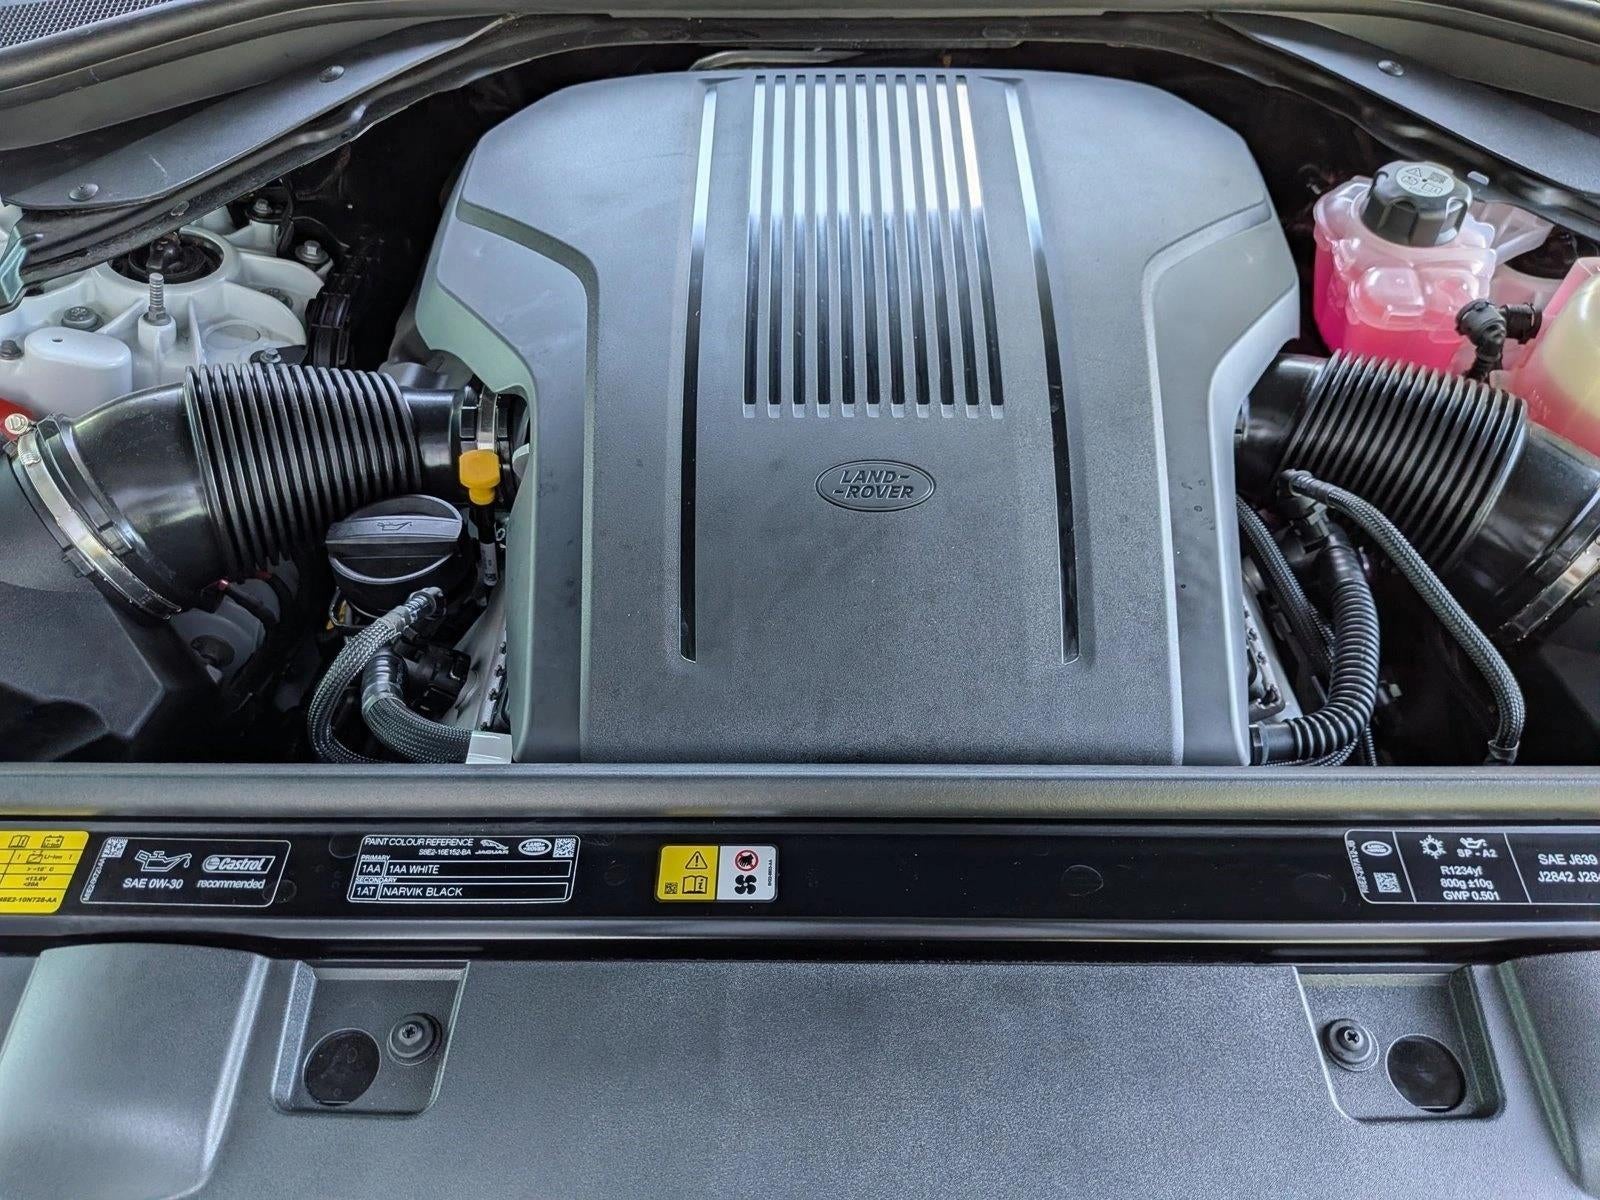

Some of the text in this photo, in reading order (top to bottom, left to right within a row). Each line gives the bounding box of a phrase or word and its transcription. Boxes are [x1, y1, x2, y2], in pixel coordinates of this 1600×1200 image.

[364, 837, 474, 847] PAINT COLOUR REFERENCE
[1457, 848, 1473, 858] SP
[1482, 848, 1499, 858] A2
[219, 857, 266, 871] Castrol
[1537, 853, 1598, 866] SAE J639
[362, 864, 381, 873] 1AA
[389, 864, 440, 874] 1AA WHITE
[1537, 870, 1576, 883] J2842
[122, 877, 184, 889] SAE 0W-30
[196, 879, 266, 890] recommended
[1440, 878, 1467, 890] 800g
[356, 887, 376, 896] 1AT
[382, 887, 463, 898] NARVIK BLACK
[1442, 890, 1500, 901] GWP 0.501
